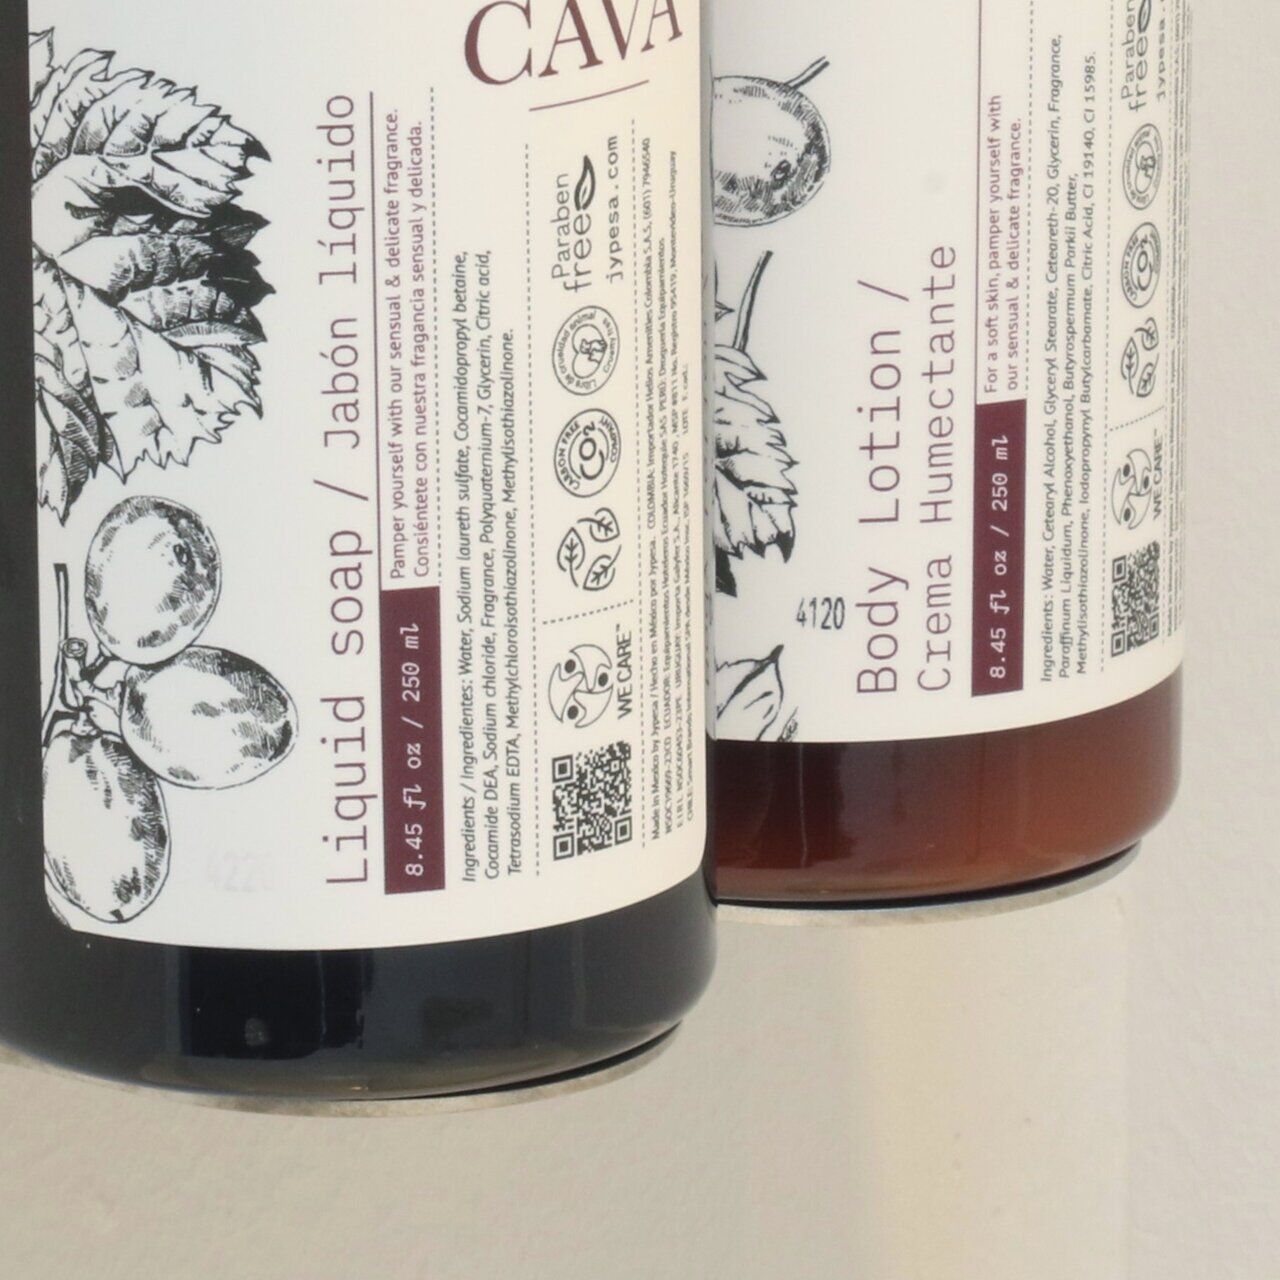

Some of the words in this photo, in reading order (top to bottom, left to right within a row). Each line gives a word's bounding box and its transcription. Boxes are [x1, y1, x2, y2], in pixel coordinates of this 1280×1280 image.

[1047, 35, 1064, 113] Fragrance,
[1083, 52, 1096, 103] 15985.
[1128, 33, 1148, 112] free
[987, 95, 1001, 133] with
[1083, 108, 1095, 124] CI
[382, 109, 403, 195] fragrance.
[406, 122, 423, 199] delicada.
[986, 136, 1003, 204] yourself
[1006, 118, 1024, 201] fragrance.
[1046, 116, 1062, 180] Glycerin,
[1082, 128, 1095, 179] 19140,
[315, 95, 365, 286] líquido
[606, 136, 623, 283] jypesa.com
[1064, 173, 1078, 222] Butter,
[1082, 184, 1094, 200] CI
[1082, 203, 1095, 240] Acid,
[383, 200, 400, 268] delicate
[408, 217, 424, 283] sensual
[550, 173, 571, 278] Paraben
[564, 214, 591, 292] free
[988, 208, 1003, 271] pamper
[1006, 205, 1020, 271] delicate
[1045, 183, 1060, 284] Ceteareth-20,
[1063, 226, 1076, 269] Parkii
[384, 275, 401, 289] &
[451, 251, 468, 313] betaine,
[474, 250, 492, 287] acid,
[985, 273, 1000, 311] skin,
[1005, 277, 1019, 290] &
[1081, 243, 1093, 281] Citric
[385, 295, 402, 360] sensual
[408, 288, 430, 368] fragancia
[474, 290, 490, 331] Citric
[984, 315, 998, 347] soft
[1005, 296, 1019, 359] sensual
[1044, 287, 1059, 353] Stearate,
[1062, 273, 1078, 391] Butyrospermum
[475, 335, 495, 401] Glycerin,
[1079, 285, 1094, 404] Butylcarbamate,
[319, 318, 360, 450] Jabón
[390, 365, 402, 394] our
[412, 373, 427, 436] nuestra
[451, 318, 472, 442] Cocamidopropyl
[919, 246, 956, 524] Humectante
[983, 367, 998, 394] For
[1007, 364, 1018, 391] our
[1043, 357, 1059, 416] Glyceryl
[387, 399, 403, 438] with
[498, 329, 519, 503] Methylisothiazolinone.
[856, 330, 901, 524] Lotion
[990, 435, 1008, 461] ml
[387, 442, 408, 511] yourself
[415, 442, 427, 472] con
[453, 445, 473, 502] sulfate,
[476, 404, 497, 544] Polyquaternium-7,
[1043, 419, 1057, 479] Alcohol,
[1060, 394, 1076, 517] Phenoxyethanol,
[1078, 409, 1093, 505] Iodopropynyl
[991, 473, 1008, 512] 250
[1041, 482, 1057, 542] Cetearyl
[389, 516, 409, 580] Pamper
[411, 477, 429, 578] Consiéntete
[455, 506, 471, 561] laureth
[1059, 521, 1074, 594] Liquidum,
[328, 530, 374, 656] soap
[455, 566, 472, 624] Sodium
[479, 548, 499, 628] Fragrance,
[994, 550, 1007, 576] oz
[1041, 545, 1055, 591] Water,
[1076, 509, 1091, 675] Methylisothiazolinone,
[399, 623, 419, 650] ml
[501, 507, 522, 730] Methylchloroisothiazolinone,
[796, 596, 846, 631] 4120
[854, 567, 909, 694] Body
[916, 555, 952, 692] Crema
[1040, 595, 1056, 682] Ingredients:
[1058, 598, 1074, 679] Paraffinum
[401, 662, 420, 703] 250
[457, 628, 474, 676] Water,
[480, 632, 498, 699] chloride,
[989, 628, 1006, 679] 8.45
[406, 743, 422, 770] oz
[458, 679, 478, 780] Ingredientes:
[481, 703, 497, 761] Sodium
[505, 733, 522, 778] EDTA,
[319, 696, 377, 884] Liquid
[482, 765, 499, 802] DEA,
[404, 824, 424, 877] 8.45
[460, 796, 480, 883] Ingredients
[483, 806, 499, 880] Cocamide
[505, 782, 522, 877] Tetrasodium
